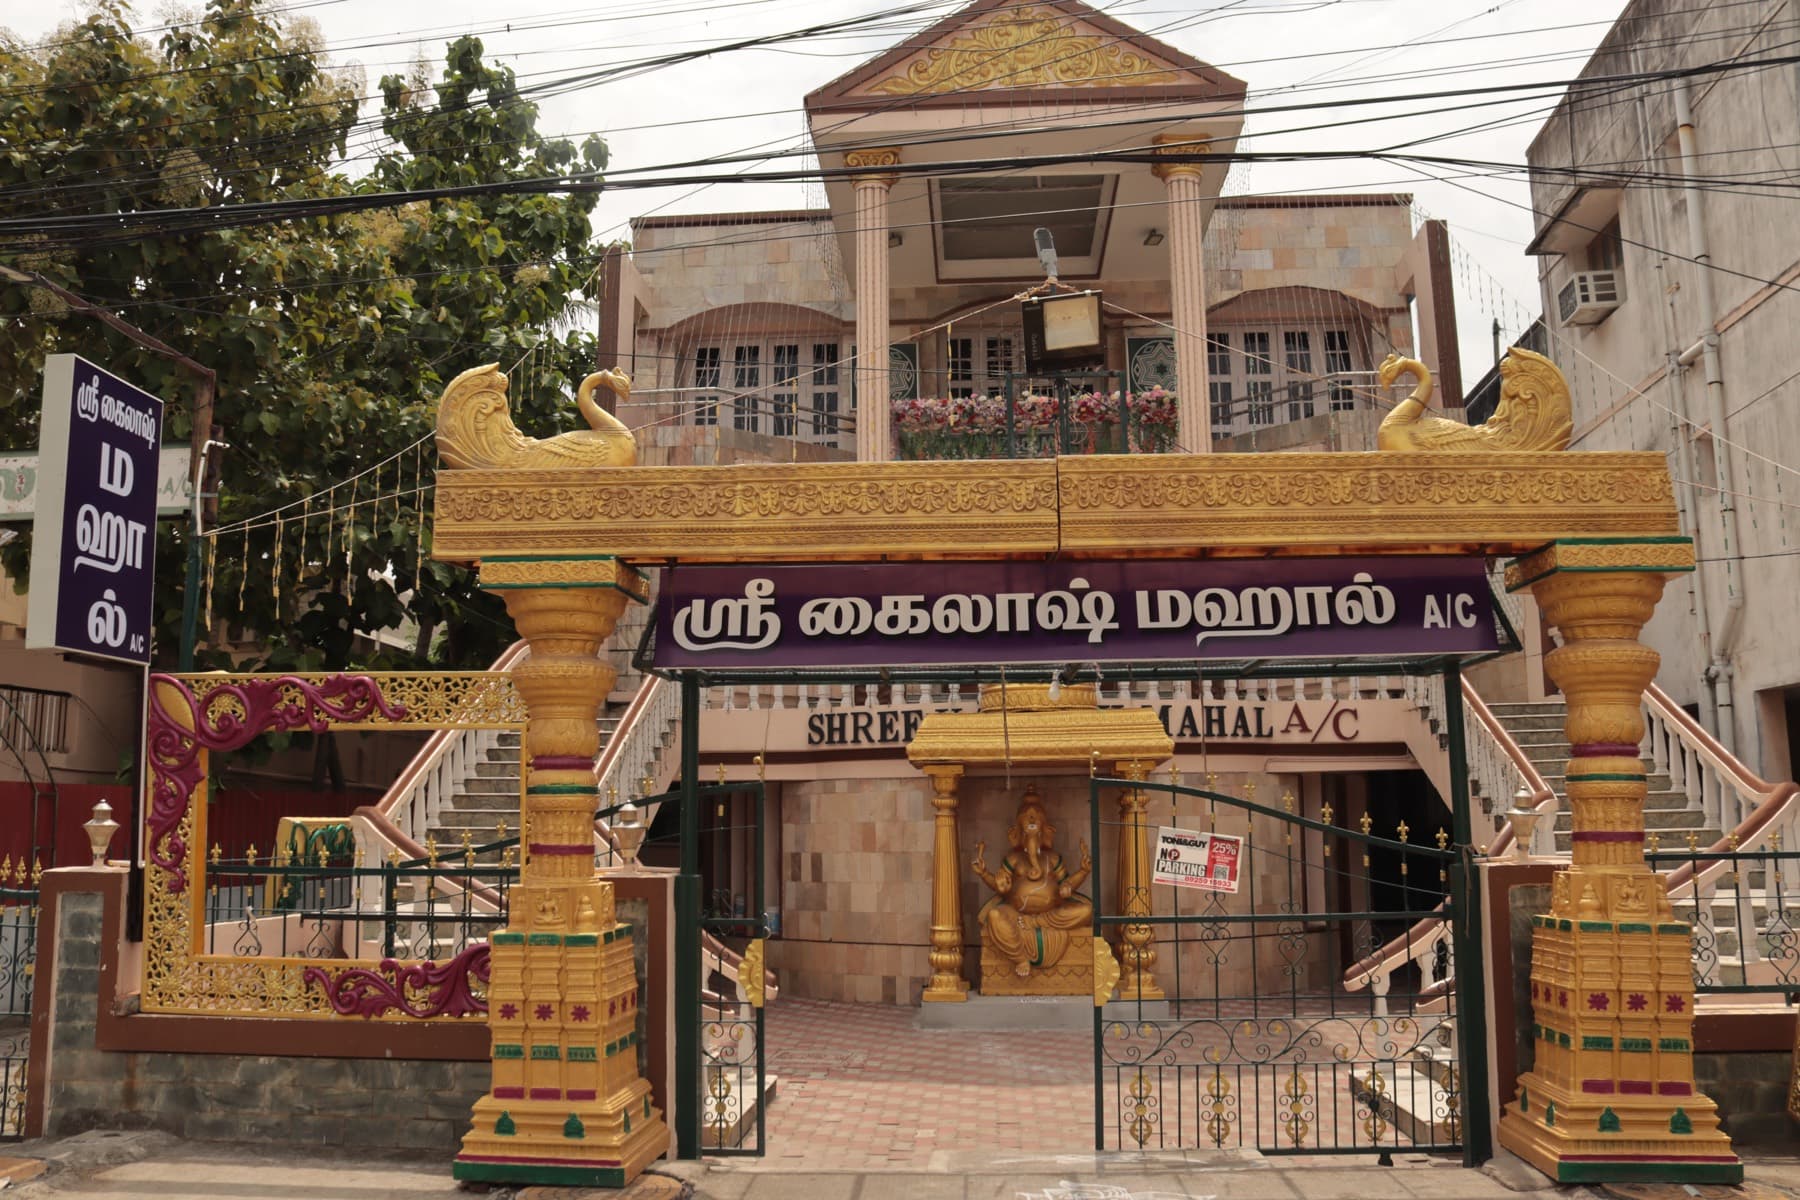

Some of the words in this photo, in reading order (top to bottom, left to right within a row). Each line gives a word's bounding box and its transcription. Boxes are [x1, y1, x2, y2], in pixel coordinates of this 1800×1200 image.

[101, 394, 156, 450] கைலாஷ்
[799, 577, 1120, 644] கைலாஷ்
[1135, 572, 1396, 648] மஹால்
[1422, 592, 1478, 629] A/C
[129, 633, 145, 654] A/C
[1279, 699, 1360, 743] A/C
[1211, 841, 1237, 856] 25%
[1158, 860, 1207, 877] PARKING
